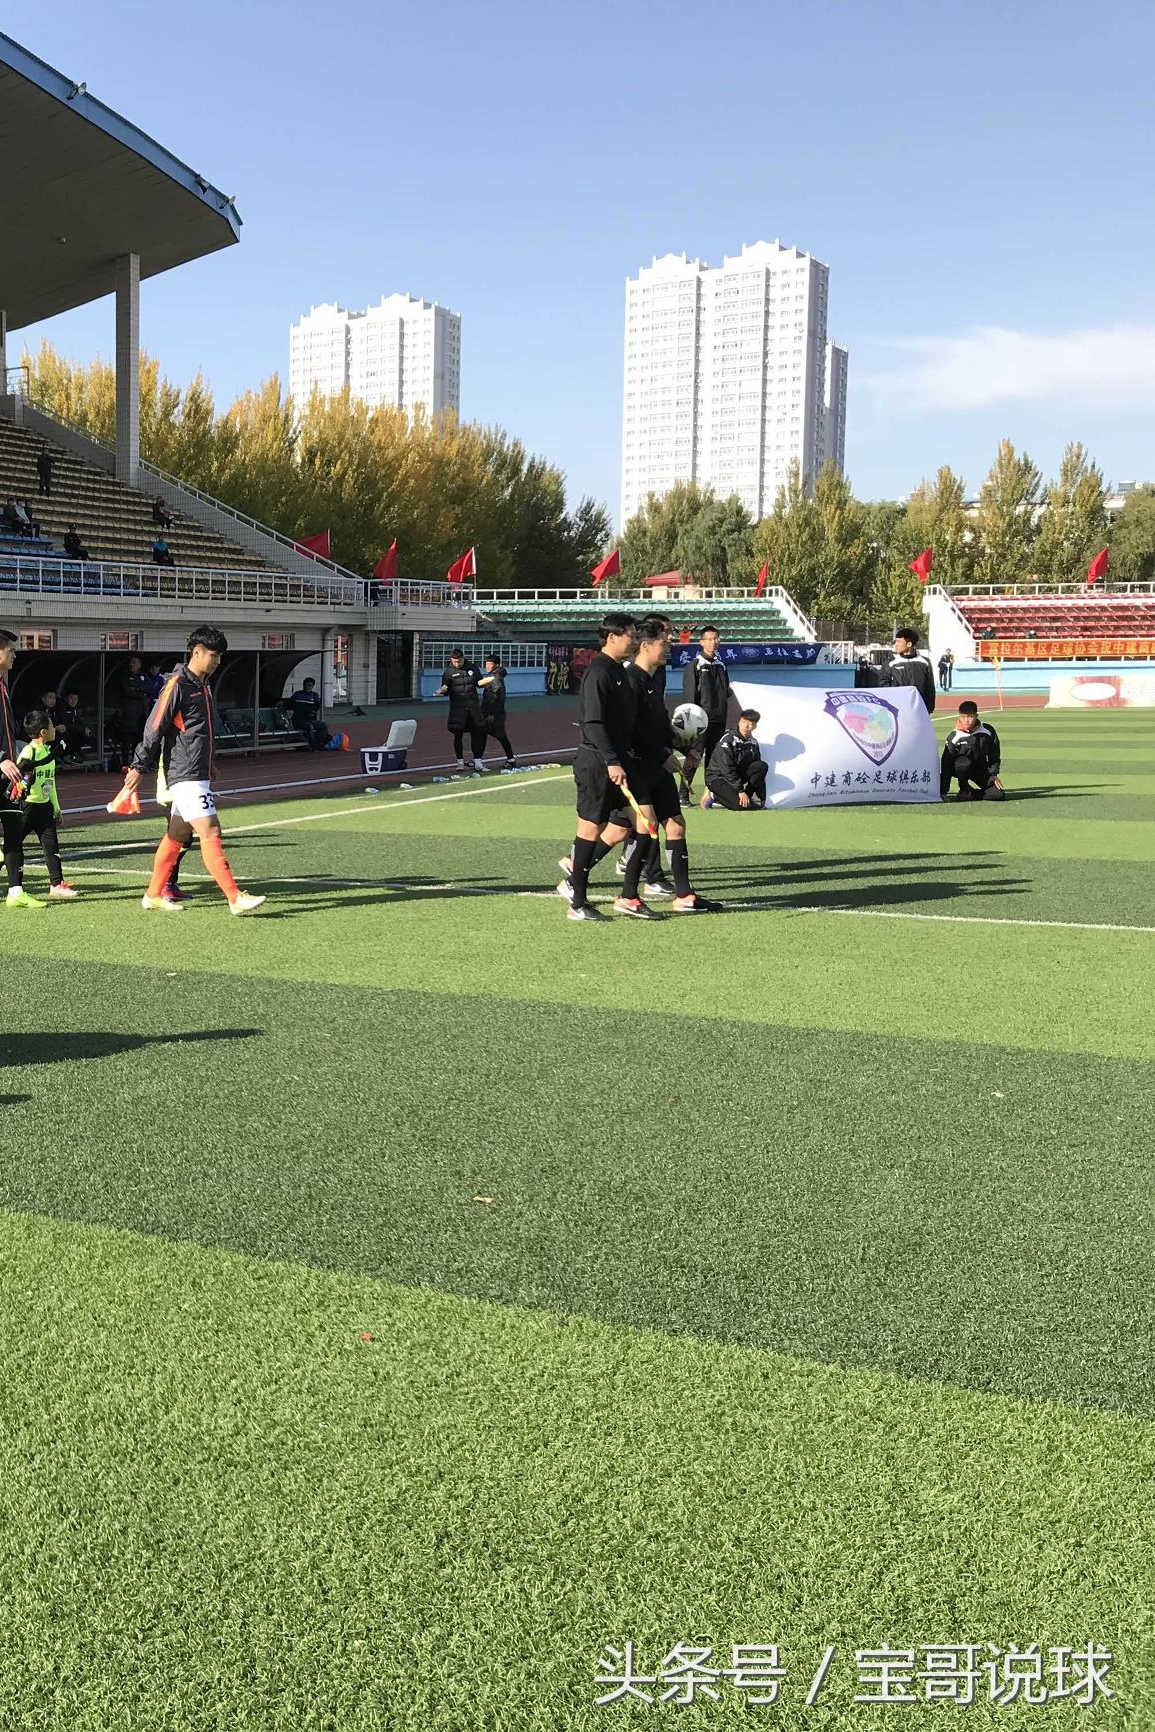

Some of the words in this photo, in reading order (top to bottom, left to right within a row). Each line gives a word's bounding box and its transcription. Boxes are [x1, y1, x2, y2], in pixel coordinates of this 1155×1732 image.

[988, 639, 1155, 656] 富拉尔基区足球协会祝中建商
[810, 768, 931, 789] 中建商砼足球俱乐部
